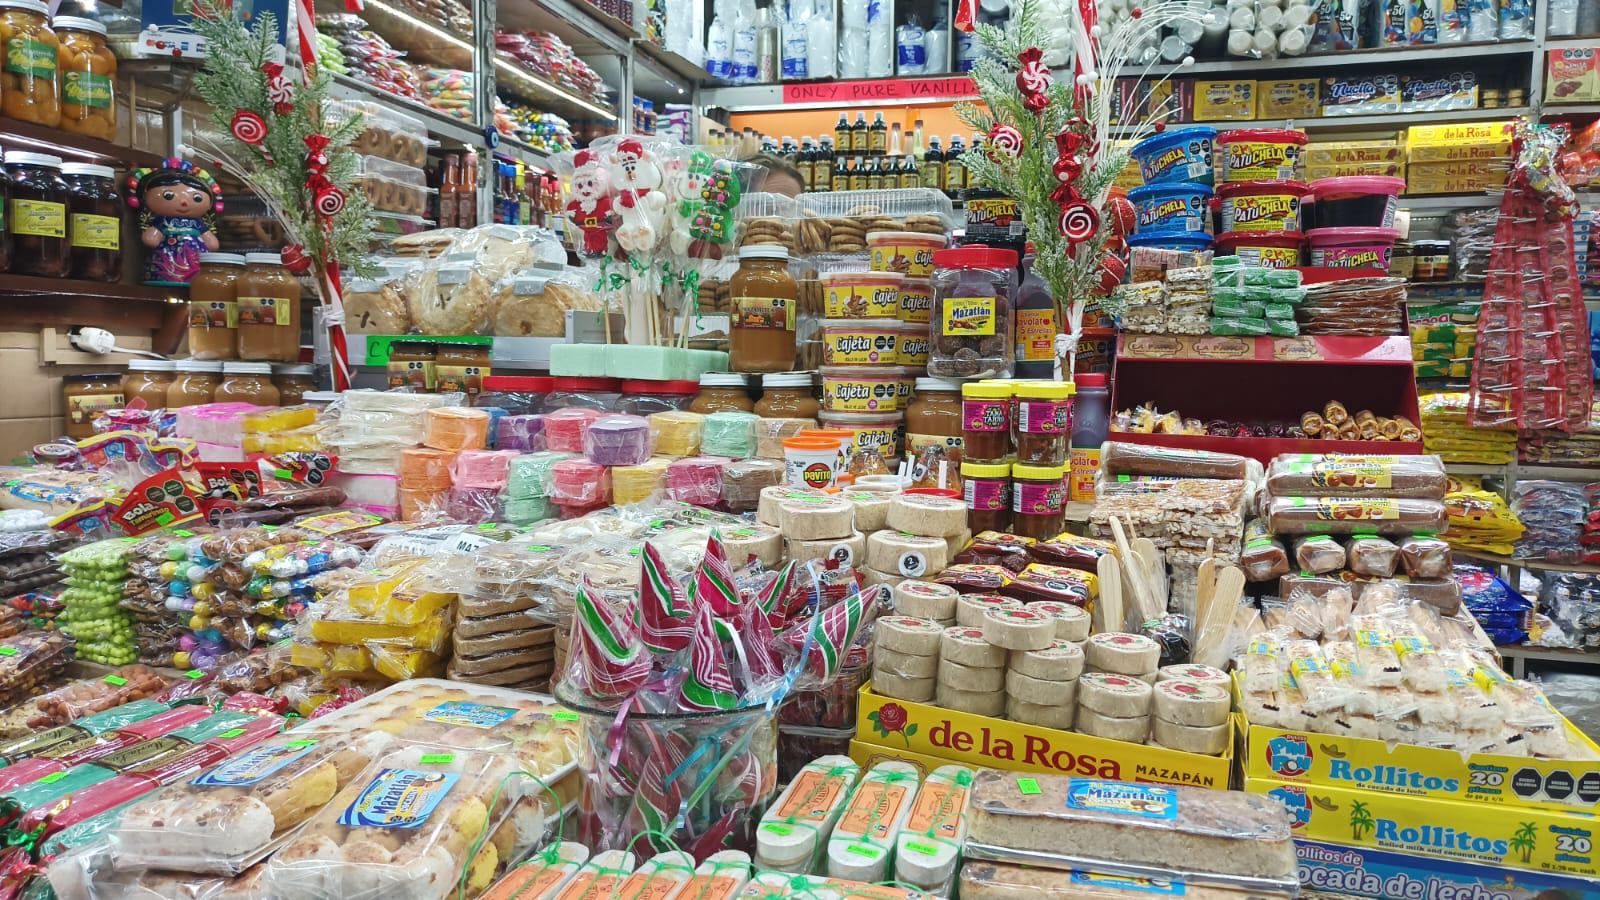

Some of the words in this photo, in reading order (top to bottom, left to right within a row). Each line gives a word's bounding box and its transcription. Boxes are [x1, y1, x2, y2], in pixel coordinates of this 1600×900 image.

[790, 86, 838, 99] ONLY
[852, 84, 899, 97] PURE
[1444, 130, 1454, 139] de
[1456, 129, 1464, 138] la
[1466, 127, 1491, 138] Rosa
[1145, 148, 1186, 178] PATUCHELA
[1230, 147, 1284, 168] PATUCHELA
[1336, 152, 1346, 162] de
[1347, 152, 1355, 161] la
[1357, 151, 1381, 162] Rosa
[1446, 150, 1457, 160] de
[1459, 149, 1468, 158] la
[1470, 147, 1496, 158] Rosa
[967, 203, 1014, 224] PATUCHELA
[1140, 200, 1186, 225] PATUCHELA
[1234, 200, 1289, 222] PATUCHELA
[836, 336, 871, 354] Cajeta
[835, 384, 870, 402] Cajeta
[928, 720, 974, 752] de
[980, 728, 1015, 760] la
[1022, 734, 1122, 780] Rosa
[1269, 737, 1308, 756] PIN
[1272, 754, 1312, 772] PON
[1136, 764, 1214, 786] MAZAPÁN
[1328, 759, 1460, 792] Rollitos
[1470, 772, 1504, 786] 20
[1375, 818, 1508, 856] Rollitos
[1556, 835, 1592, 853] 20
[1295, 848, 1342, 863] ollitos
[1343, 851, 1362, 865] de
[1378, 840, 1404, 848] Rolled
[1406, 842, 1425, 852] milk
[1444, 848, 1476, 858] coconut
[1478, 853, 1503, 863] candy
[1298, 866, 1381, 895] ocada
[1384, 876, 1424, 900] de
